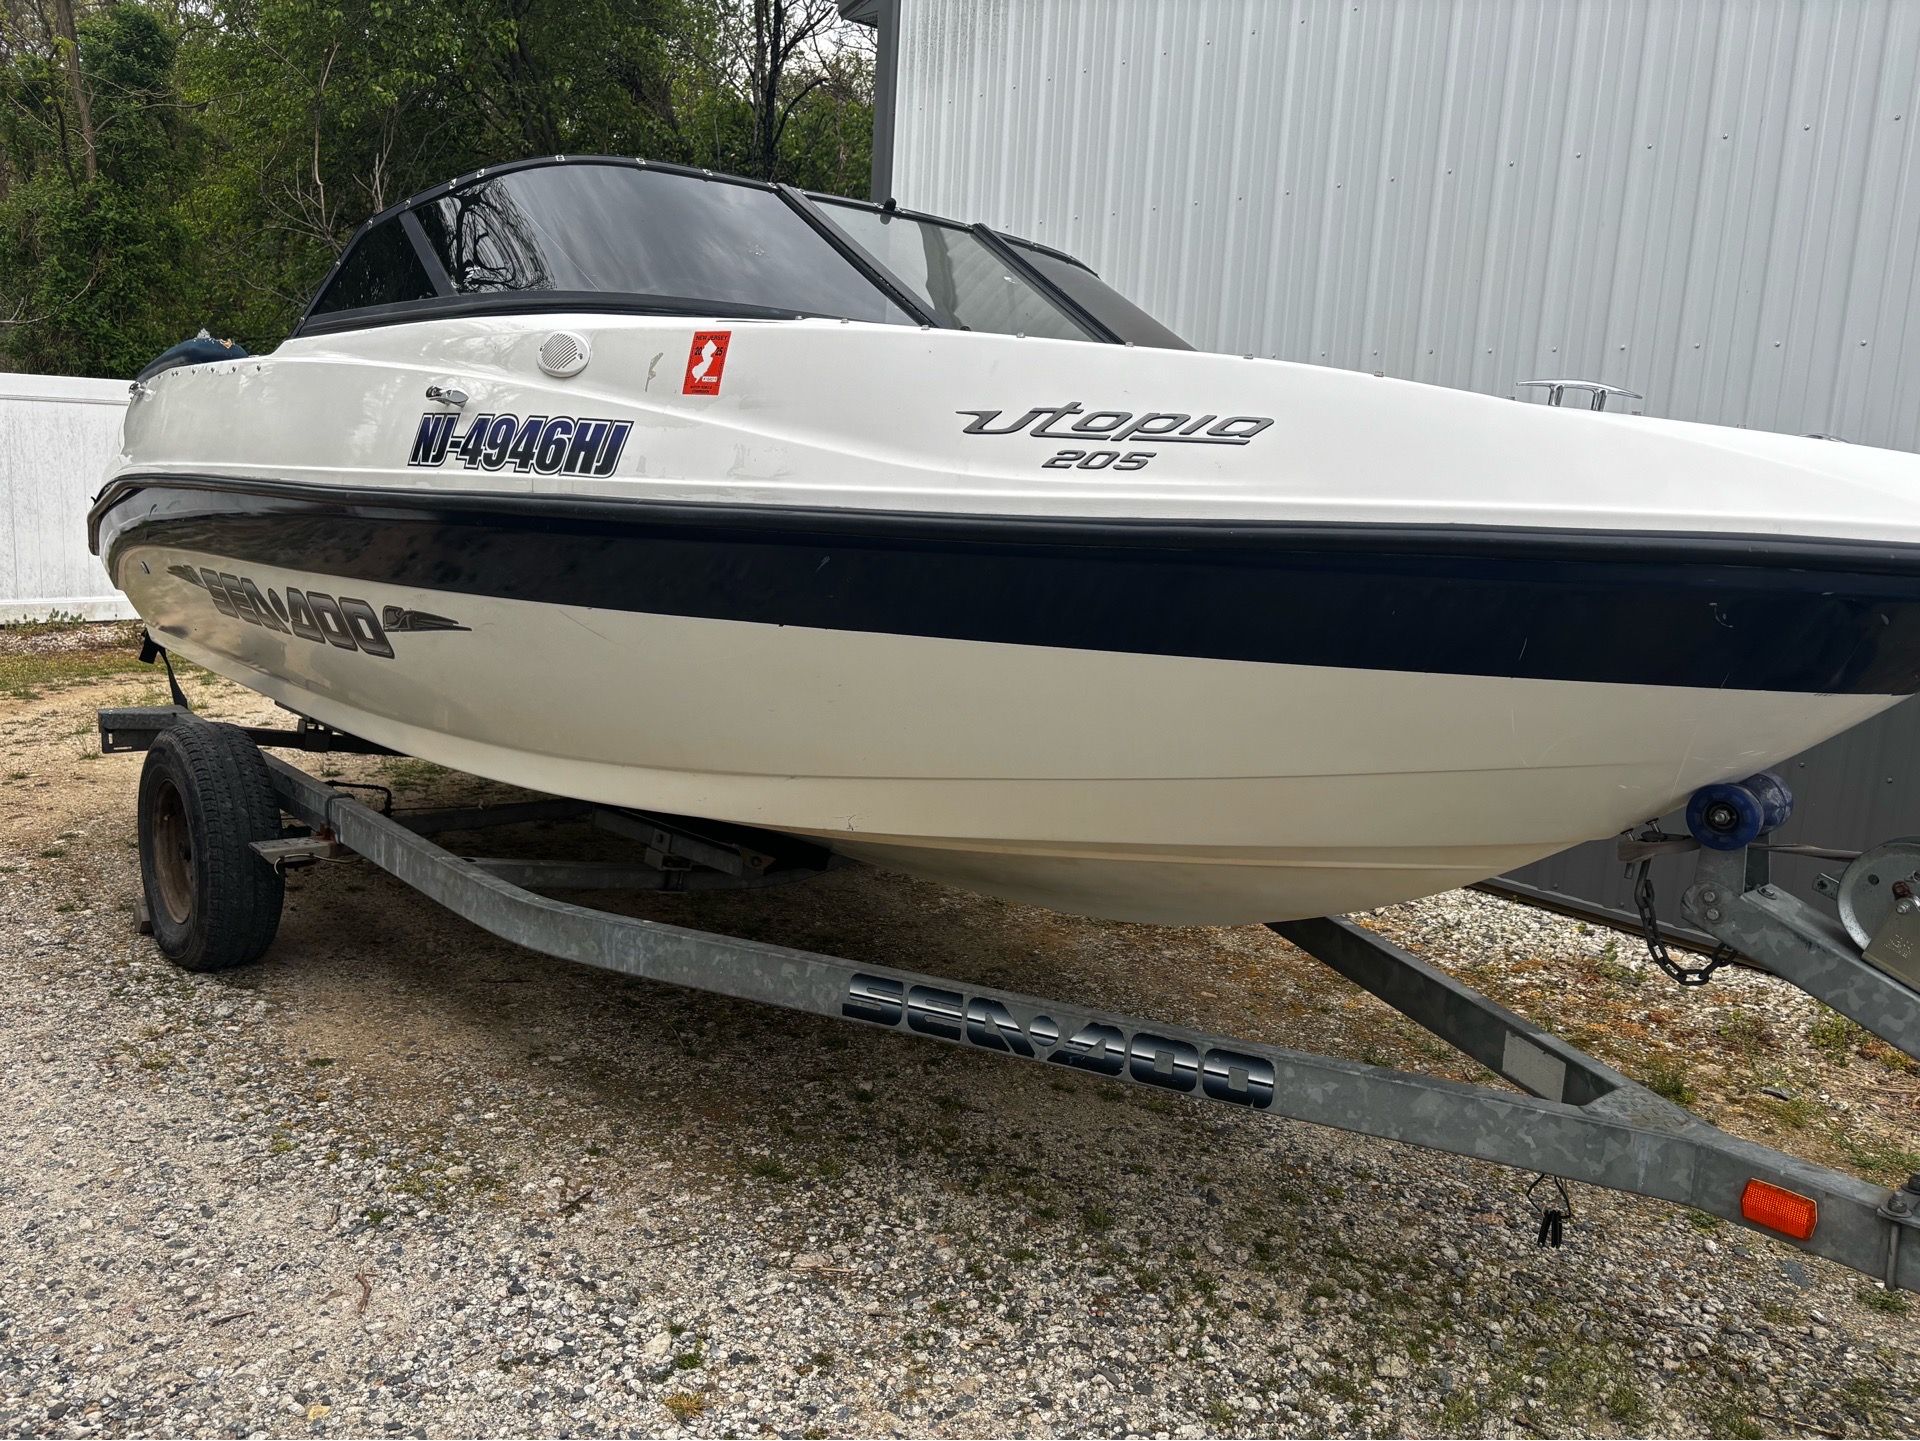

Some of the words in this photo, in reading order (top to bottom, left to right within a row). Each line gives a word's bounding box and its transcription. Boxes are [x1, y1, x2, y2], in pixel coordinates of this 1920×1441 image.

[407, 412, 634, 478] NJ-4946HJ
[955, 401, 1275, 445] Utopia
[1041, 449, 1157, 470] 205
